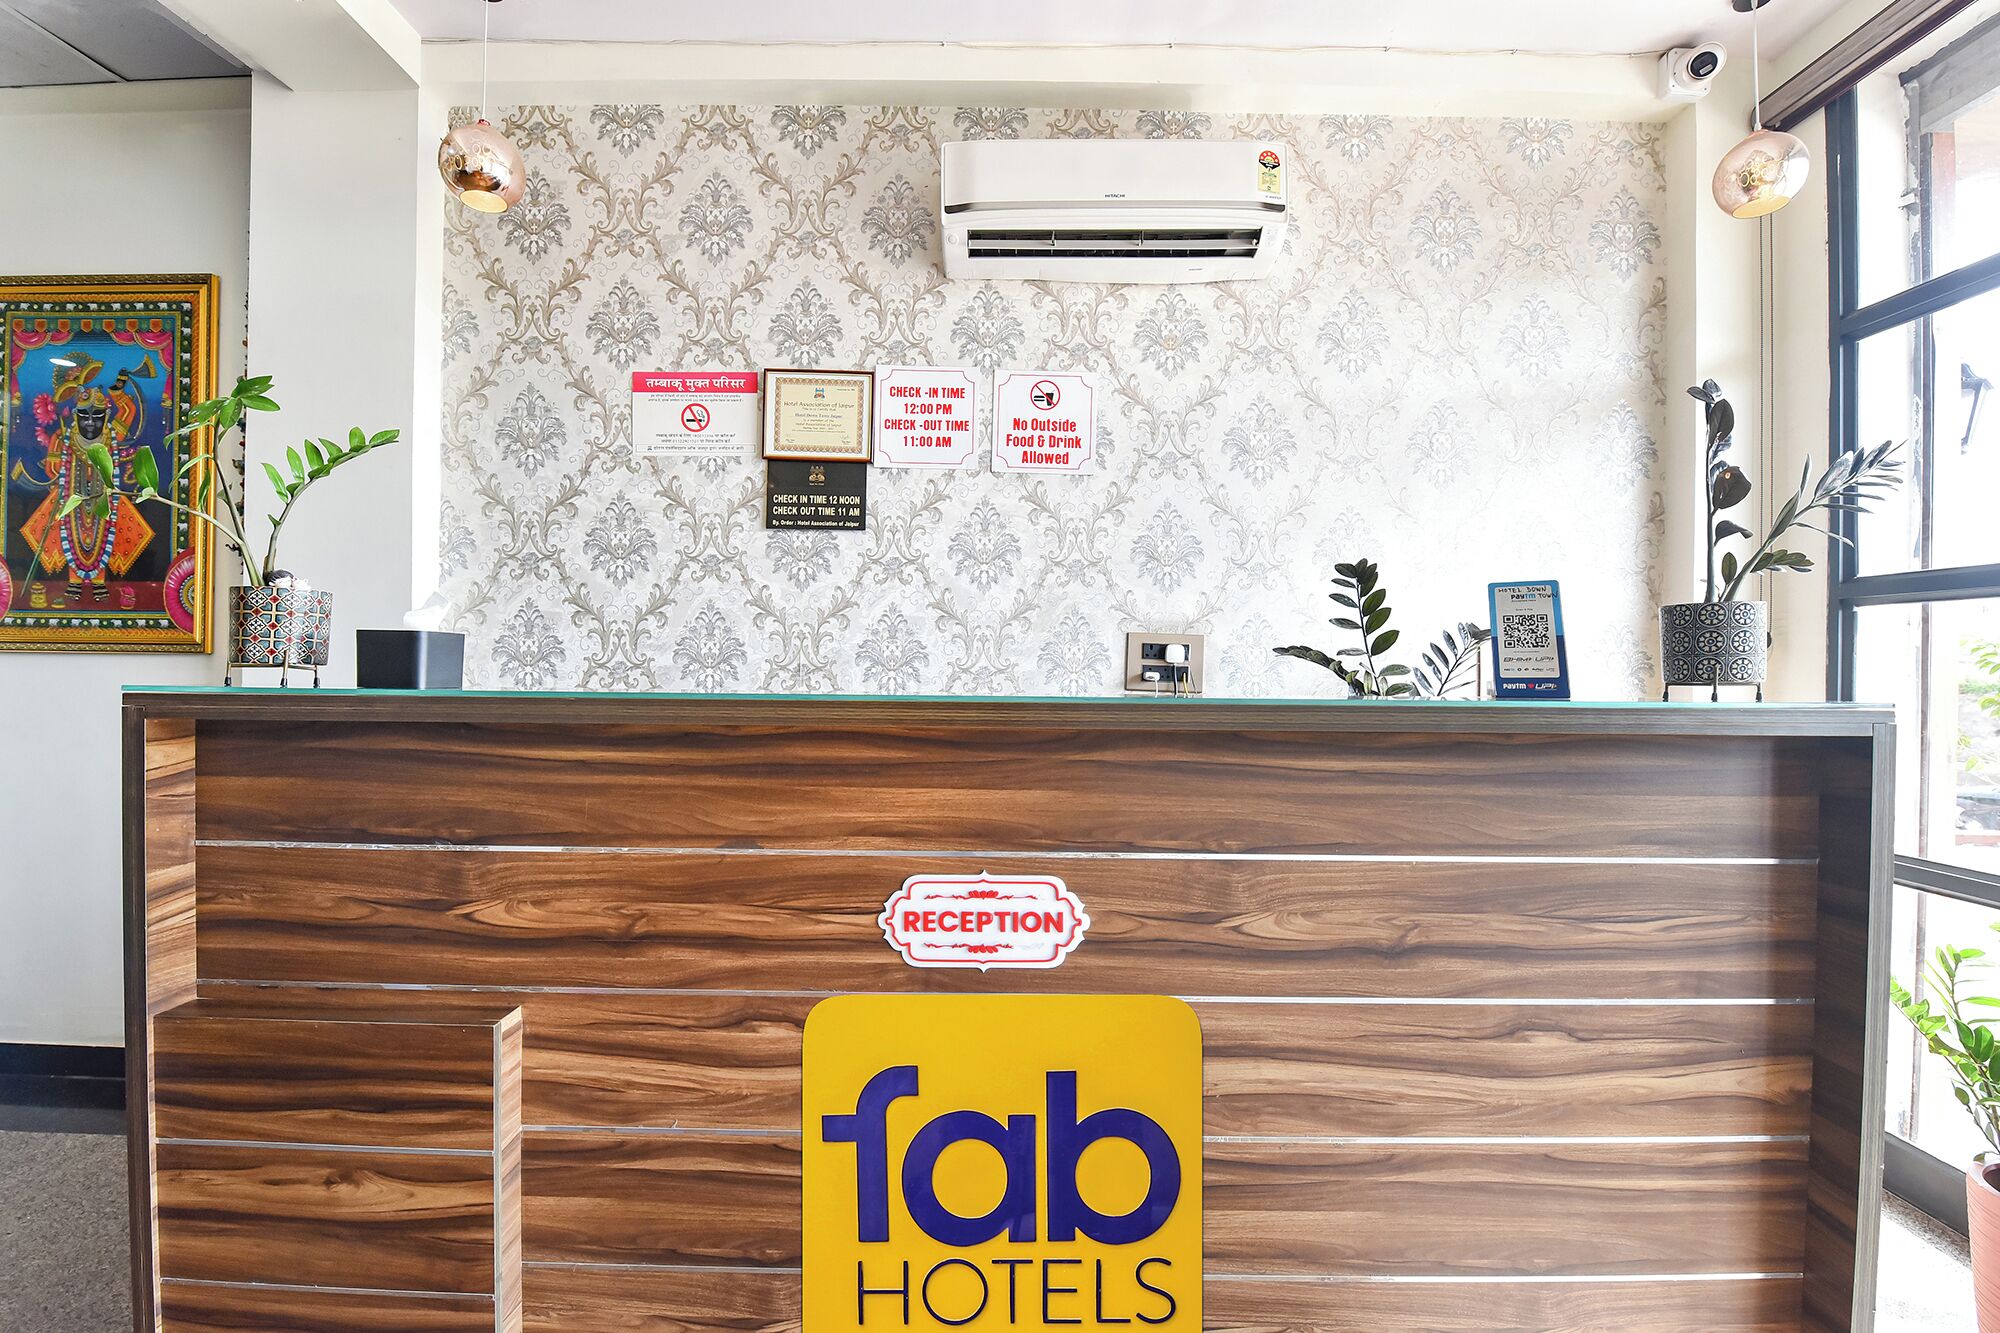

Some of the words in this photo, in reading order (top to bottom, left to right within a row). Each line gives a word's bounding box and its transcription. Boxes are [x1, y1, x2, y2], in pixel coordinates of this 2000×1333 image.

[646, 378, 685, 391] तम्बाकू
[685, 378, 710, 391] मुक्त
[712, 376, 746, 388] परिसर
[890, 386, 920, 397] CHECK
[941, 387, 966, 399] TIME
[904, 403, 934, 414] 12:00
[936, 404, 952, 415] PM
[884, 420, 916, 431] CHECK
[946, 420, 970, 432] TIME
[1013, 418, 1028, 431] No
[1031, 418, 1077, 432] Outside
[904, 436, 933, 447] 11:00
[935, 436, 952, 448] AM
[1006, 434, 1034, 448] Food
[1037, 435, 1045, 448] &
[1050, 435, 1082, 449] Drink
[1022, 450, 1069, 465] Allowed
[773, 495, 798, 503] CHECK
[800, 495, 807, 503] IN
[810, 495, 827, 504] TIME
[829, 496, 838, 504] 12
[840, 496, 860, 504] NOON
[773, 506, 798, 515] CHECK
[800, 507, 815, 515] OUT
[818, 507, 835, 516] TIME
[849, 508, 860, 516] AM
[903, 911, 1064, 932] RECEPTION
[822, 1065, 1182, 1246] fab
[857, 1257, 1176, 1326] HOTELS
